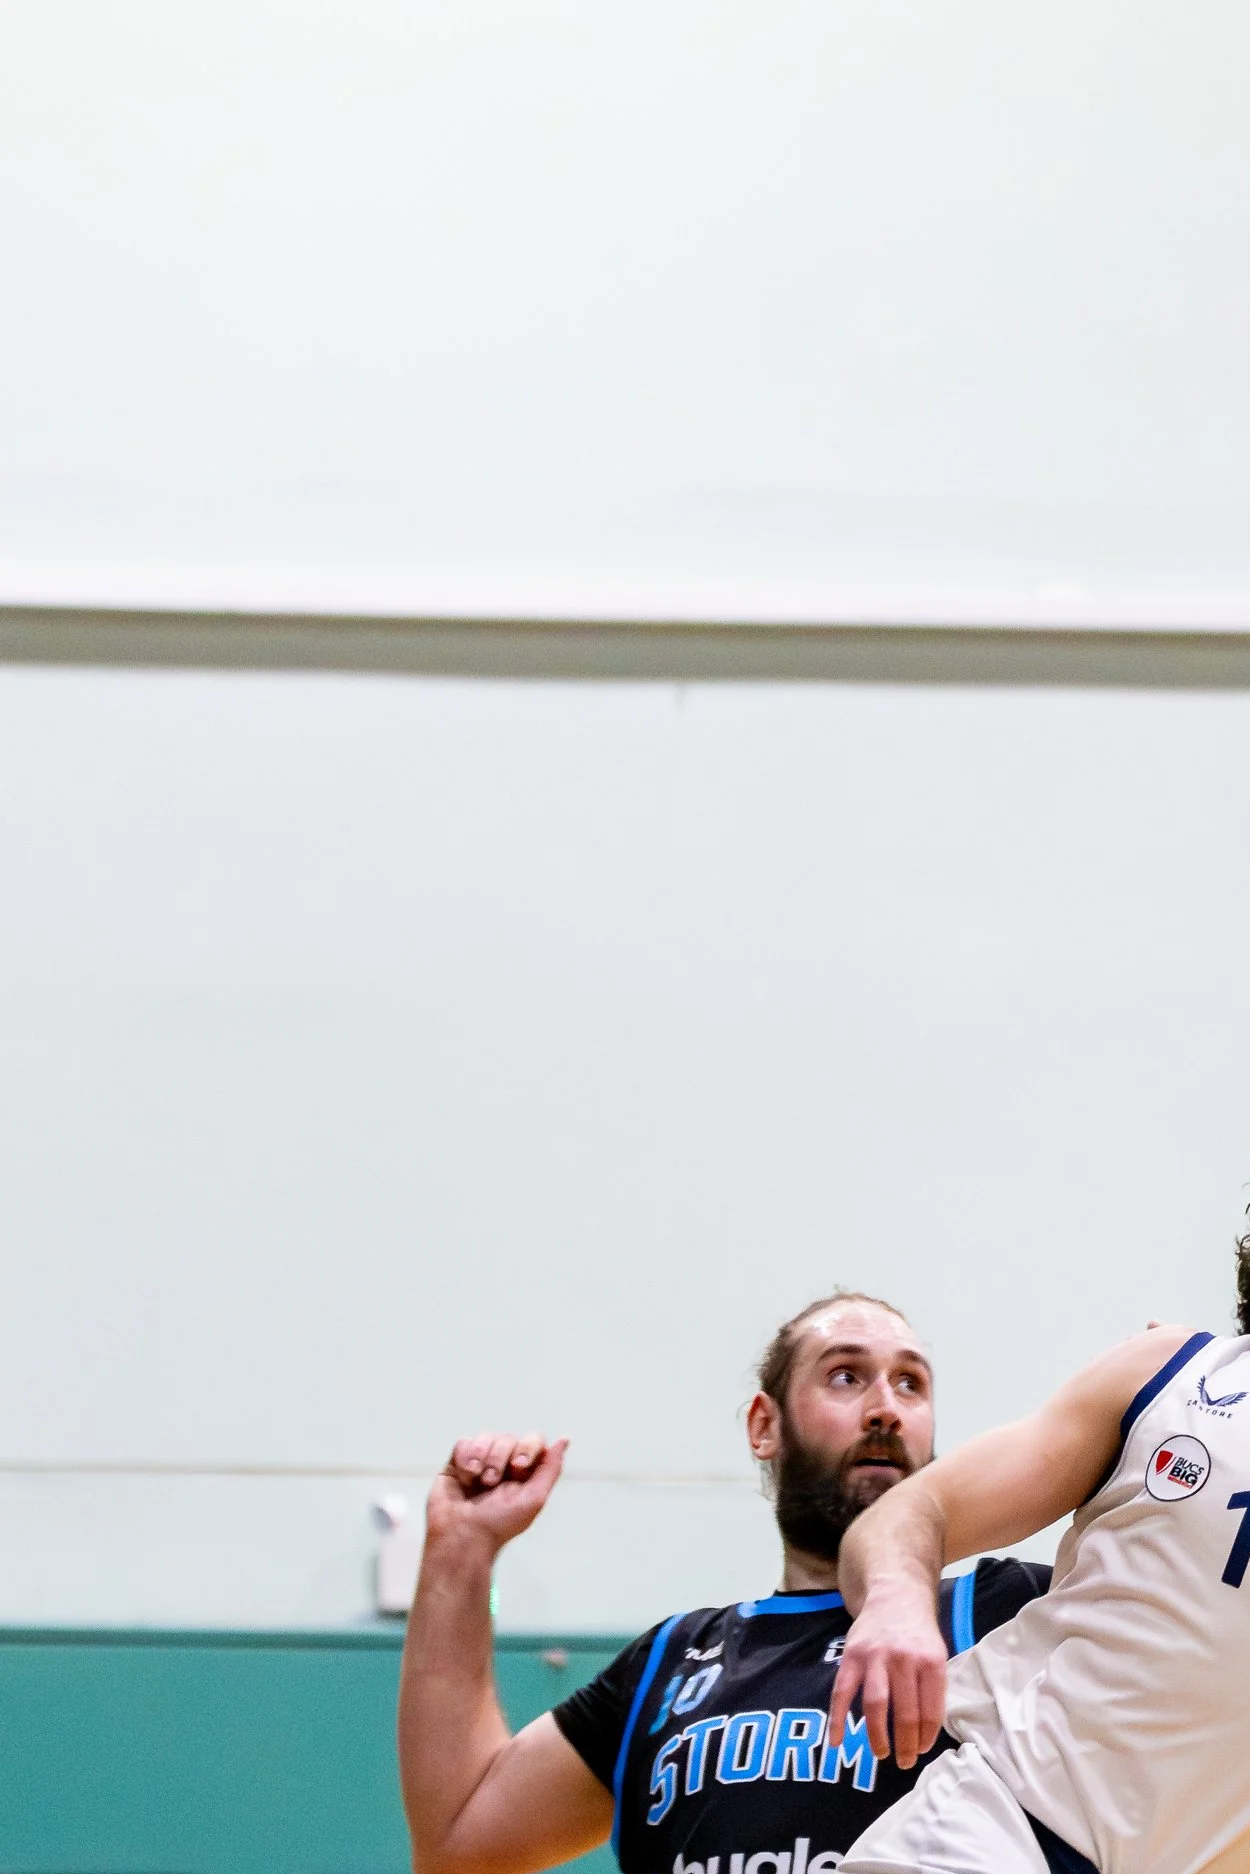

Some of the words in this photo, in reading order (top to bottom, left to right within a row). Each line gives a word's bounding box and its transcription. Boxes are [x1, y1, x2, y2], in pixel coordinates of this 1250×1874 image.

[1169, 1465, 1199, 1487] BIG
[1174, 1456, 1205, 1476] BUCS
[646, 1707, 879, 1826] STORM
